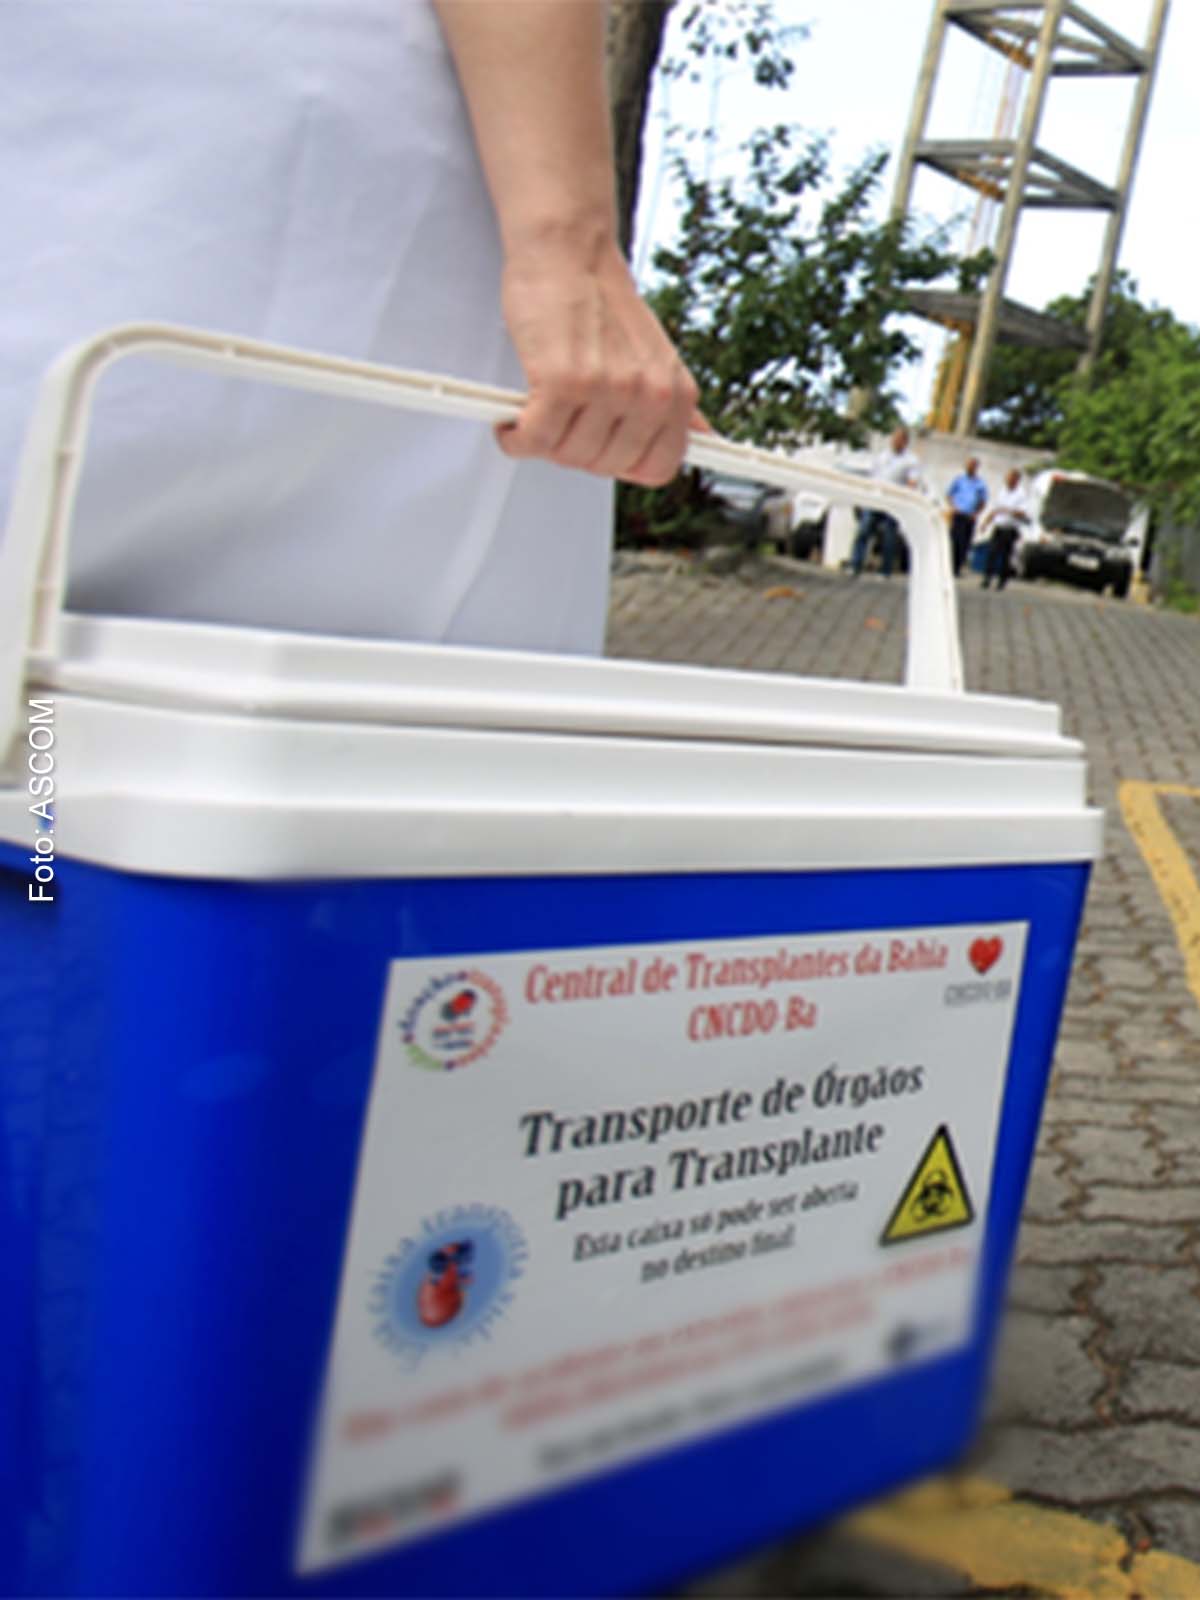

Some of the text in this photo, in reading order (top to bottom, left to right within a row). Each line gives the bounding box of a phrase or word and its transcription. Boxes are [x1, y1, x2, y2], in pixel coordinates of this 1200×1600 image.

[524, 935, 949, 1005] Central de Transplantes da Bahia
[687, 994, 818, 1042] CNCDO Ba
[517, 1062, 926, 1158] Transporte de Órgãos
[554, 1121, 886, 1221] para Transplante
[572, 1231, 622, 1262] Esta
[626, 1216, 685, 1250] caixa
[714, 1198, 765, 1234] pode
[766, 1192, 798, 1215] ser
[799, 1180, 861, 1211] aberta
[639, 1257, 670, 1284] no
[671, 1241, 748, 1276] destino
